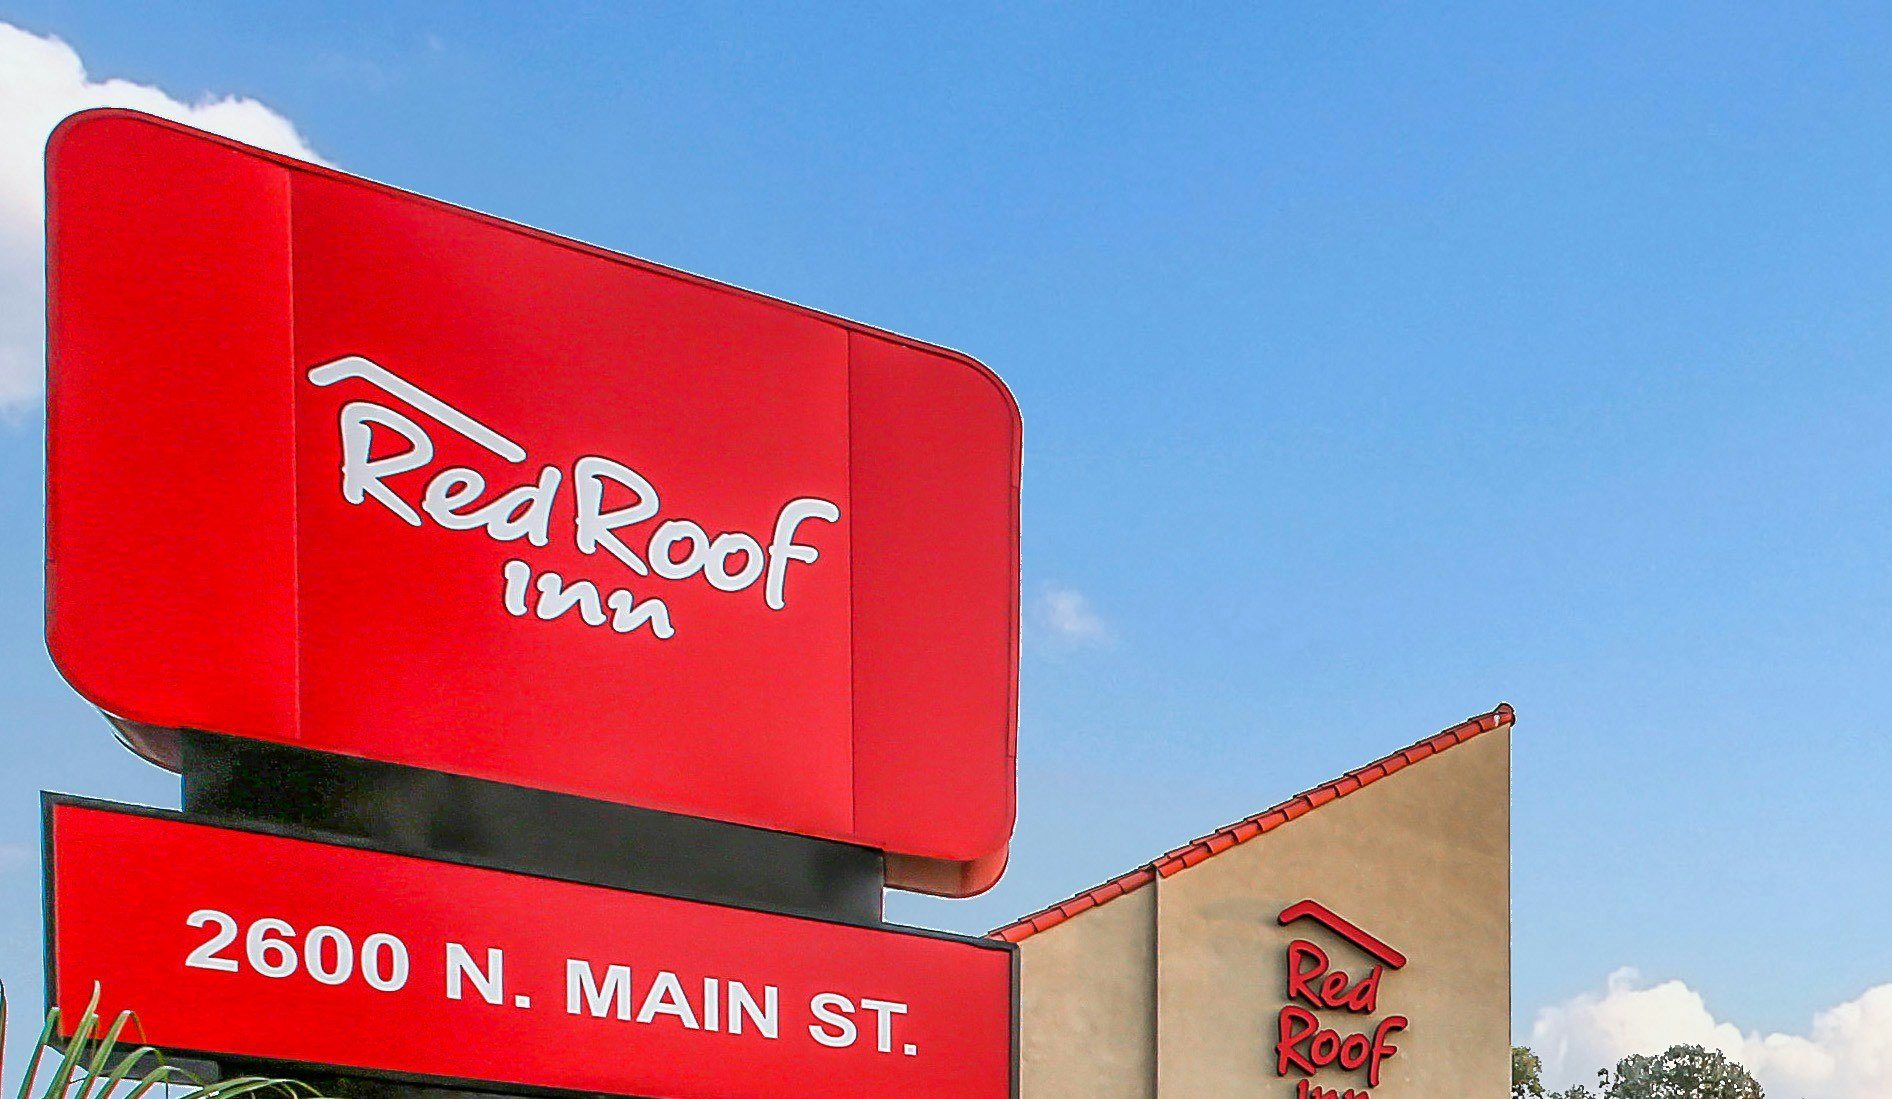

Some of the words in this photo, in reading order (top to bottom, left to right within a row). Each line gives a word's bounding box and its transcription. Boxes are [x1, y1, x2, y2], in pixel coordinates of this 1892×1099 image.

[503, 559, 676, 640] Inn
[183, 908, 411, 993] 2600
[445, 941, 532, 1010] N.
[565, 957, 780, 1040] MAIN
[807, 991, 918, 1057] ST.
[1287, 939, 1384, 1014] Red
[1275, 1004, 1409, 1088] Roof
